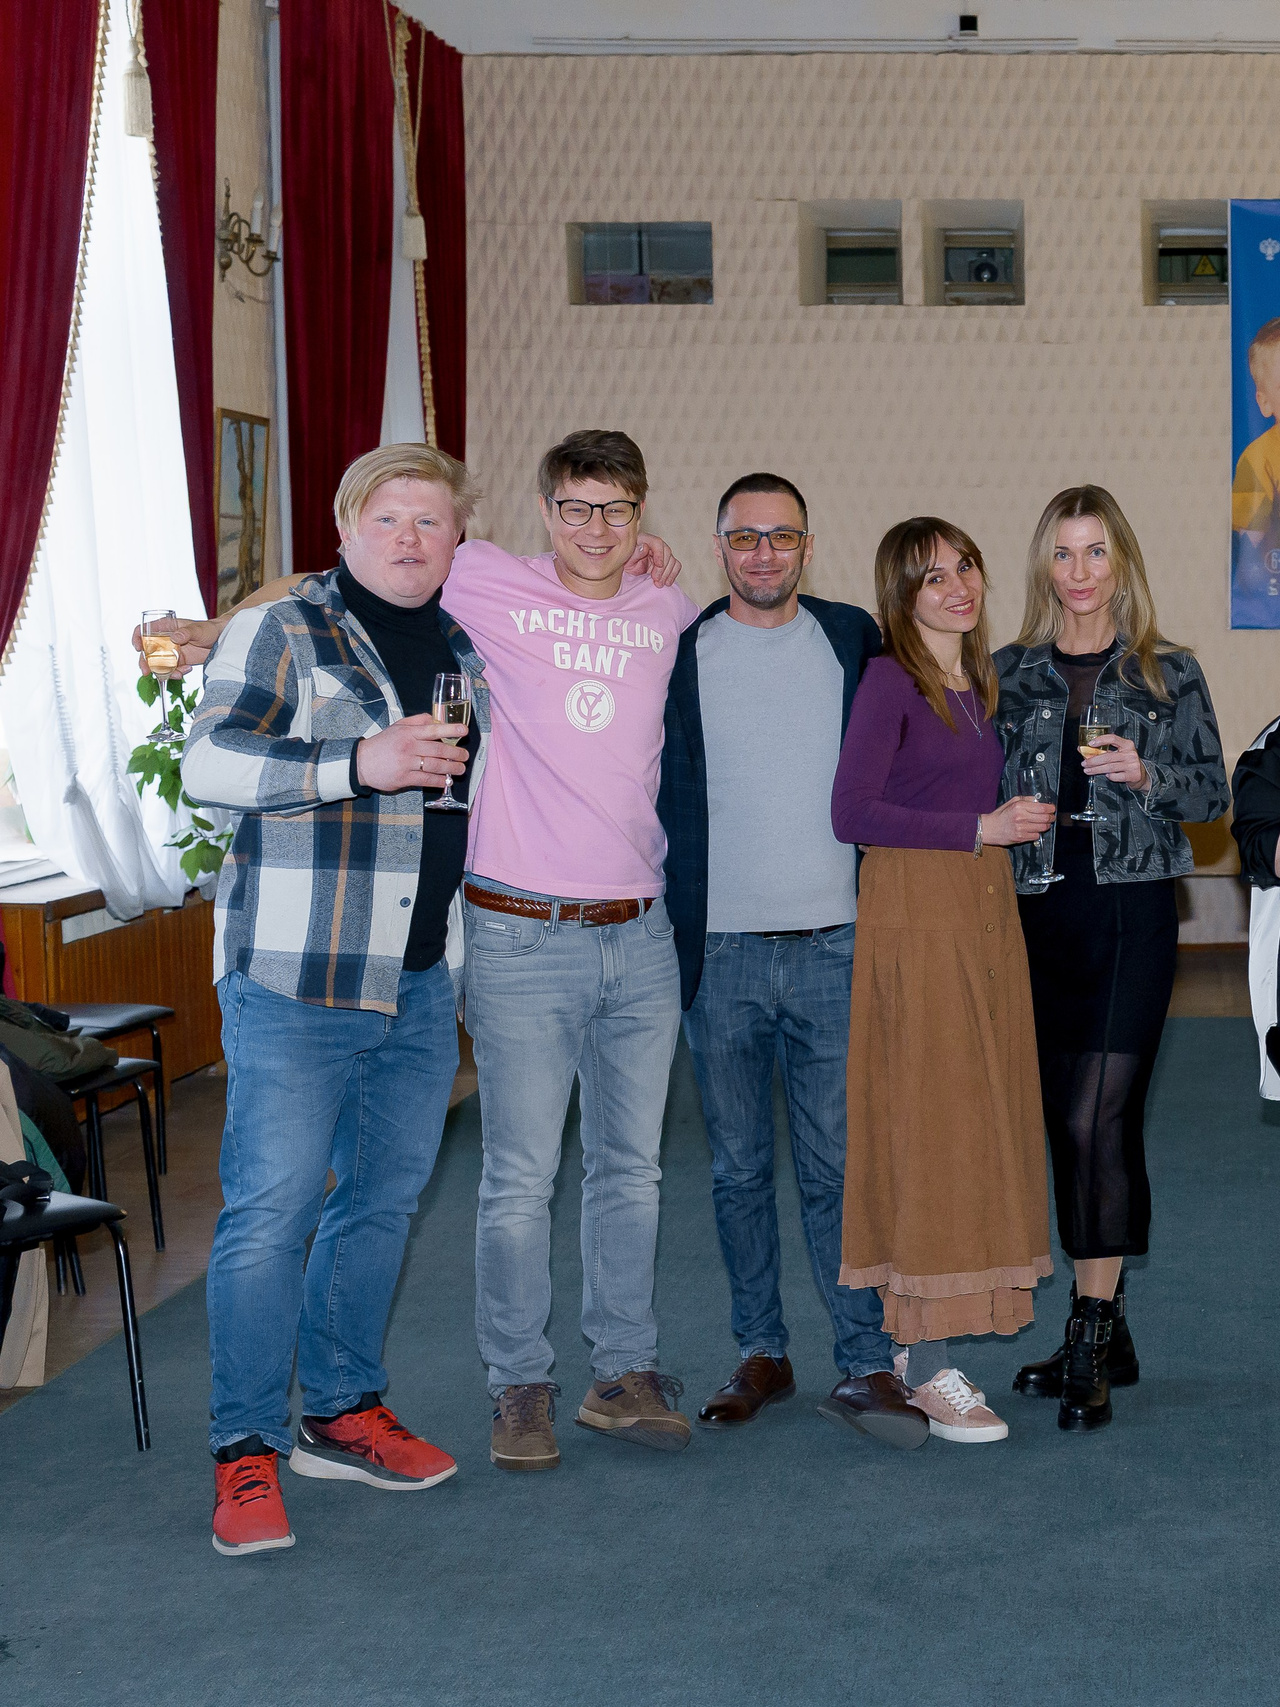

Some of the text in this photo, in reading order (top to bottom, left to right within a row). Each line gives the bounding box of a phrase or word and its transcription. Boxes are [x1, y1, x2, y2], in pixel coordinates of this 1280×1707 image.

[508, 609, 664, 655] YACHT CLUB
[553, 641, 632, 678] GANT
